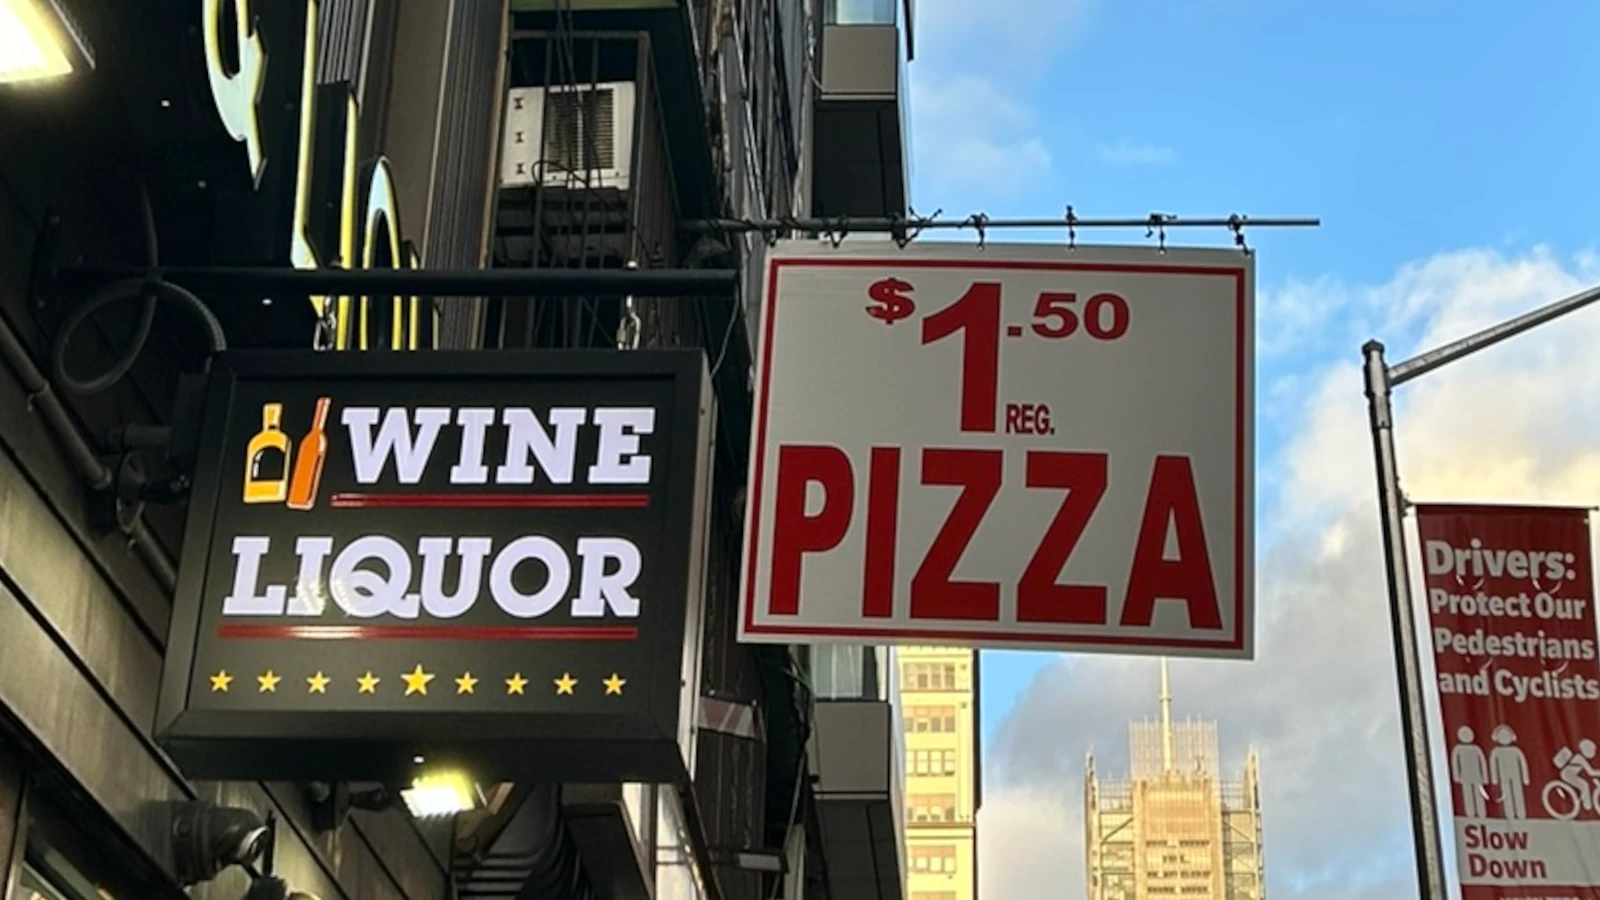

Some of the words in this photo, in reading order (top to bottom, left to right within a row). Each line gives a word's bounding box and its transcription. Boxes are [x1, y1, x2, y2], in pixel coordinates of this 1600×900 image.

[1005, 403, 1056, 435] REG.
[341, 407, 656, 485] WINE
[767, 444, 1223, 630] PIZZA
[222, 535, 643, 619] LIQUOR
[1425, 537, 1577, 582] Drivers:
[1430, 588, 1532, 618] Protect
[1534, 592, 1587, 621] Our
[1434, 626, 1596, 661] Pedestrians
[1440, 668, 1490, 697] and
[1494, 670, 1600, 704] Cyclists
[1464, 824, 1529, 851] Slow
[1468, 853, 1548, 880] Down
